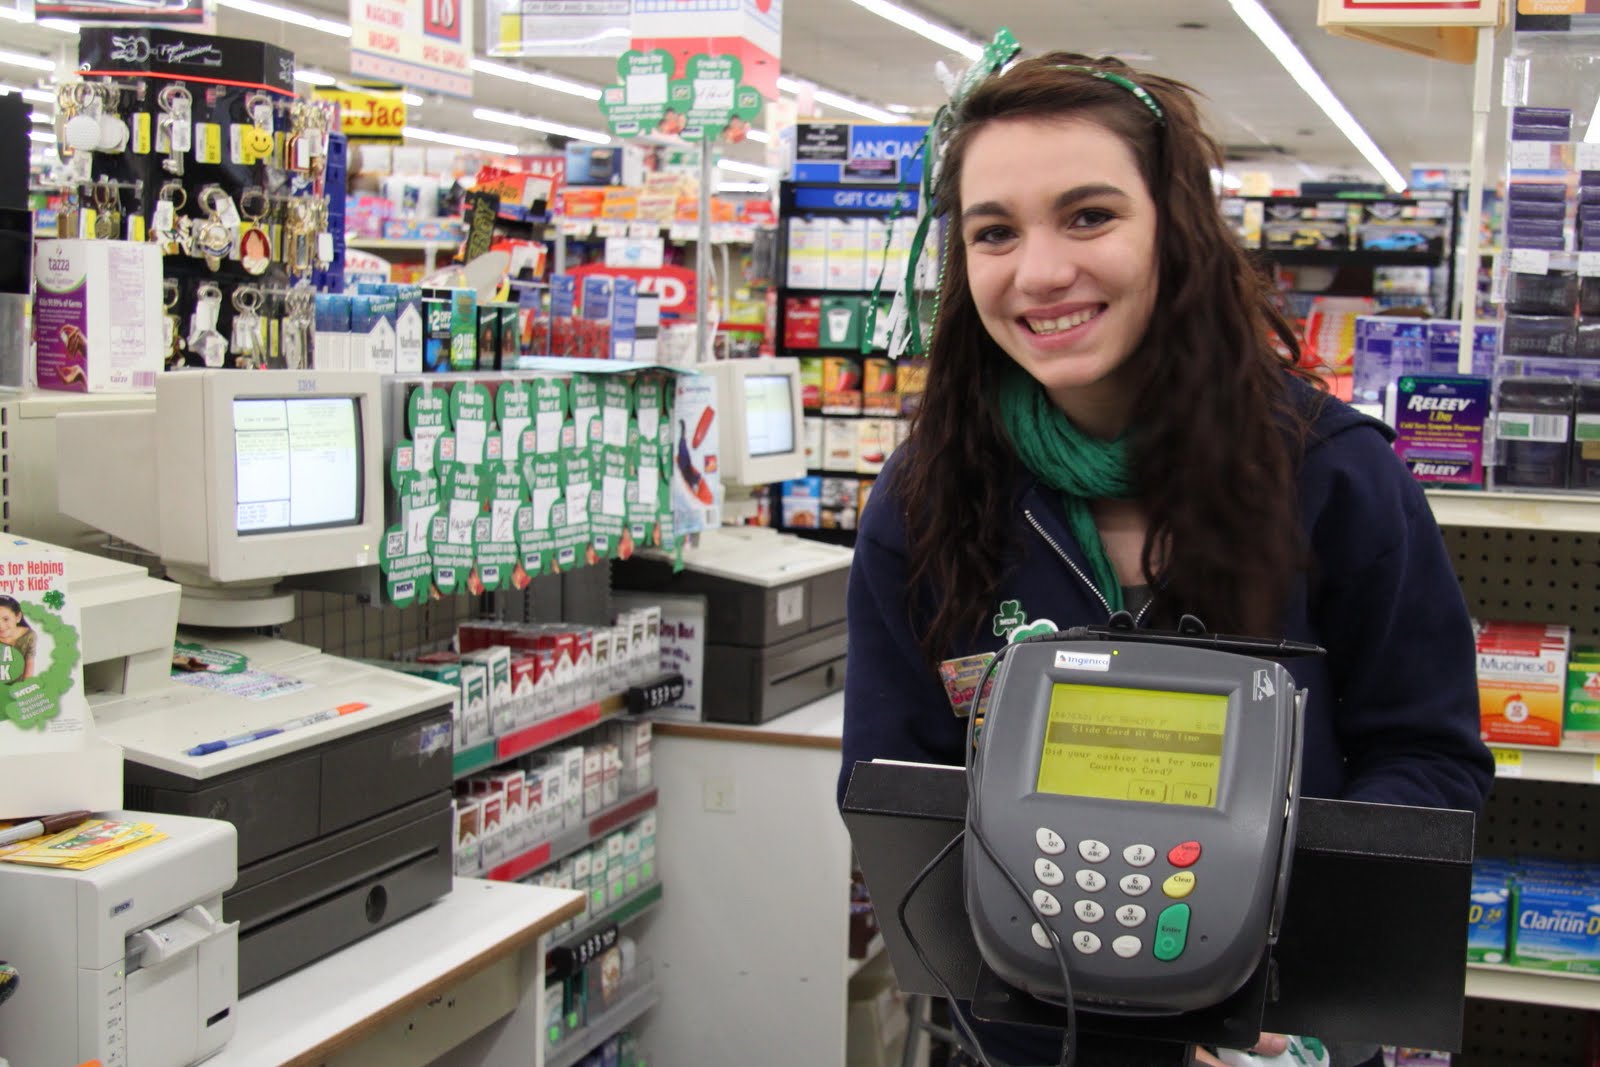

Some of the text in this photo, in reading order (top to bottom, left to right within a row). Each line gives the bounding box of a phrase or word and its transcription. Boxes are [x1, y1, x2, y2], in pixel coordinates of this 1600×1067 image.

[833, 192, 864, 207] GIFT
[8, 562, 24, 576] for
[27, 560, 64, 576] Helping
[396, 582, 413, 593] MDA
[1072, 725, 1100, 735] Slide
[1107, 727, 1130, 736] Card
[1152, 731, 1170, 741] Any
[1177, 733, 1200, 742] Time
[1045, 748, 1062, 756] Did
[1068, 751, 1091, 760] your
[1097, 753, 1137, 762] cashier
[1168, 757, 1184, 766] for
[1191, 761, 1214, 770] your
[1090, 762, 1172, 776] Courtesy Card?
[1138, 786, 1198, 799] Yes No
[1048, 832, 1052, 840] 1
[1132, 876, 1138, 884] 6
[1173, 875, 1192, 883] Clear
